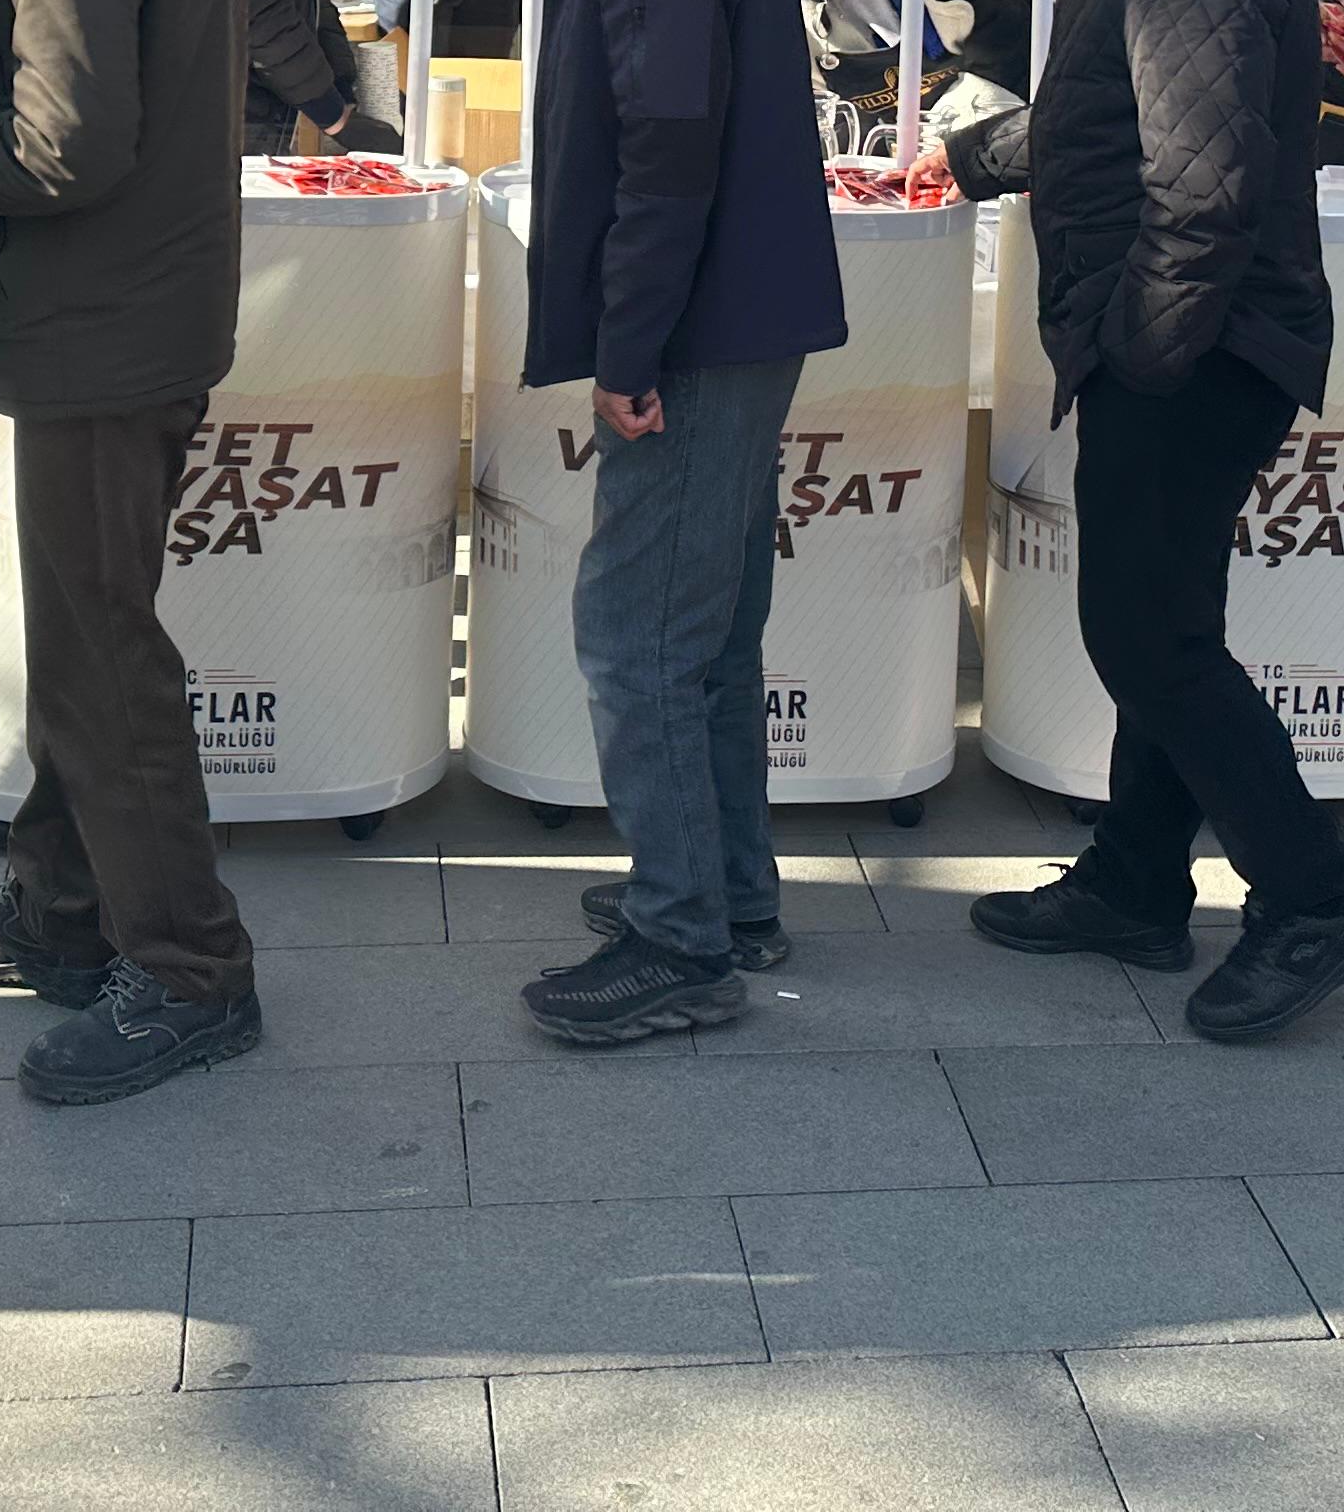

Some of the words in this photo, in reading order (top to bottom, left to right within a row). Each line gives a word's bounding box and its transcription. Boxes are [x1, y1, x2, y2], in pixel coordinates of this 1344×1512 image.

[785, 468, 922, 528] ŞAT
[167, 510, 263, 566] ŞA
[1233, 515, 1344, 568] AŞA
[1262, 664, 1287, 680] T.C.
[188, 692, 276, 723] FLAR
[196, 727, 275, 749] ÜRLÜĞÜ
[203, 757, 276, 775] ÜDÜRLÜĞÜ
[768, 752, 807, 768] RLÜĞÜ
